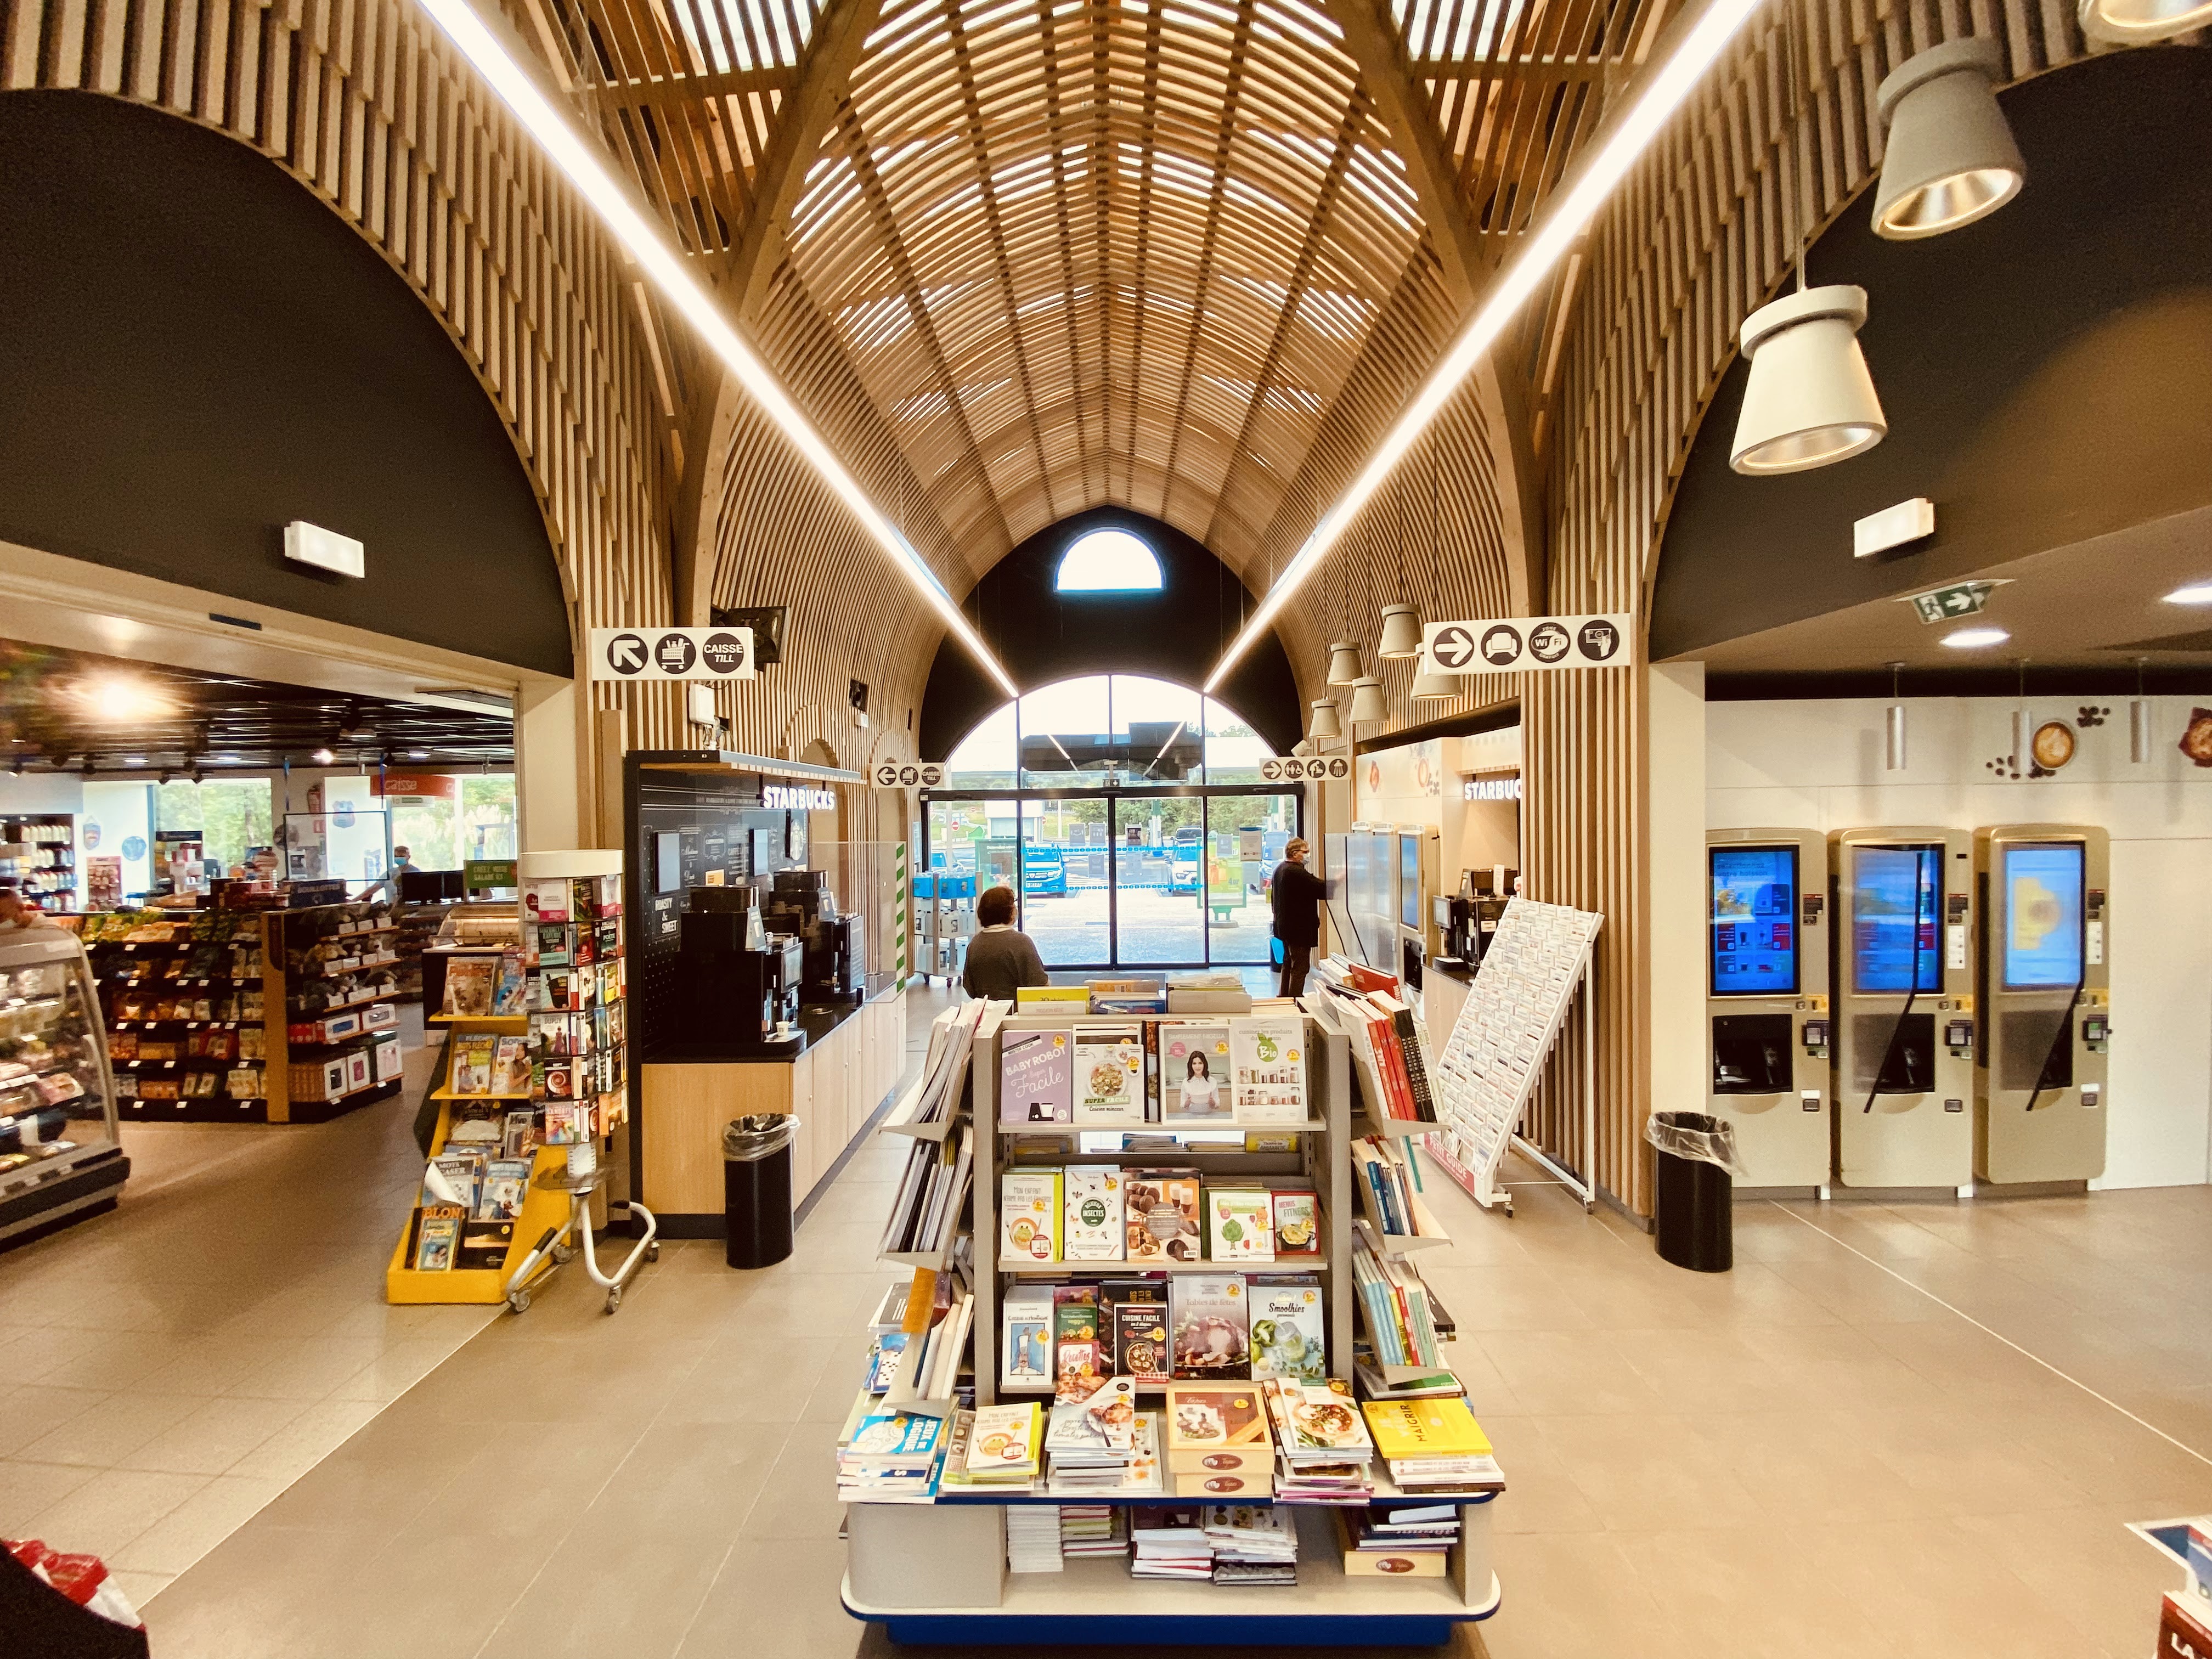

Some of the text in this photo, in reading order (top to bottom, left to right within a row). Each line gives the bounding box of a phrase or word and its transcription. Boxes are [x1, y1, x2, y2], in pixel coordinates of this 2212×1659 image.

[704, 644, 743, 653] CAISSE
[1535, 639, 1548, 647] Wi
[714, 654, 734, 663] TILL
[385, 777, 417, 791] caisse
[763, 786, 834, 810] STARBUCKS
[1259, 1045, 1277, 1059] Bio
[1006, 1047, 1066, 1076] BABY ROBOT
[1011, 1066, 1064, 1098] Facile
[1429, 1135, 1444, 1158] PETIT
[1446, 1153, 1468, 1179] GUIDE
[1268, 1302, 1305, 1313] Smoothies
[1142, 1314, 1160, 1322] FACILE
[1063, 1348, 1091, 1364] Recettes
[921, 1419, 938, 1440] JEUX
[1400, 1404, 1427, 1442] MAIGRIR
[902, 1417, 926, 1453] LOGIQUE
